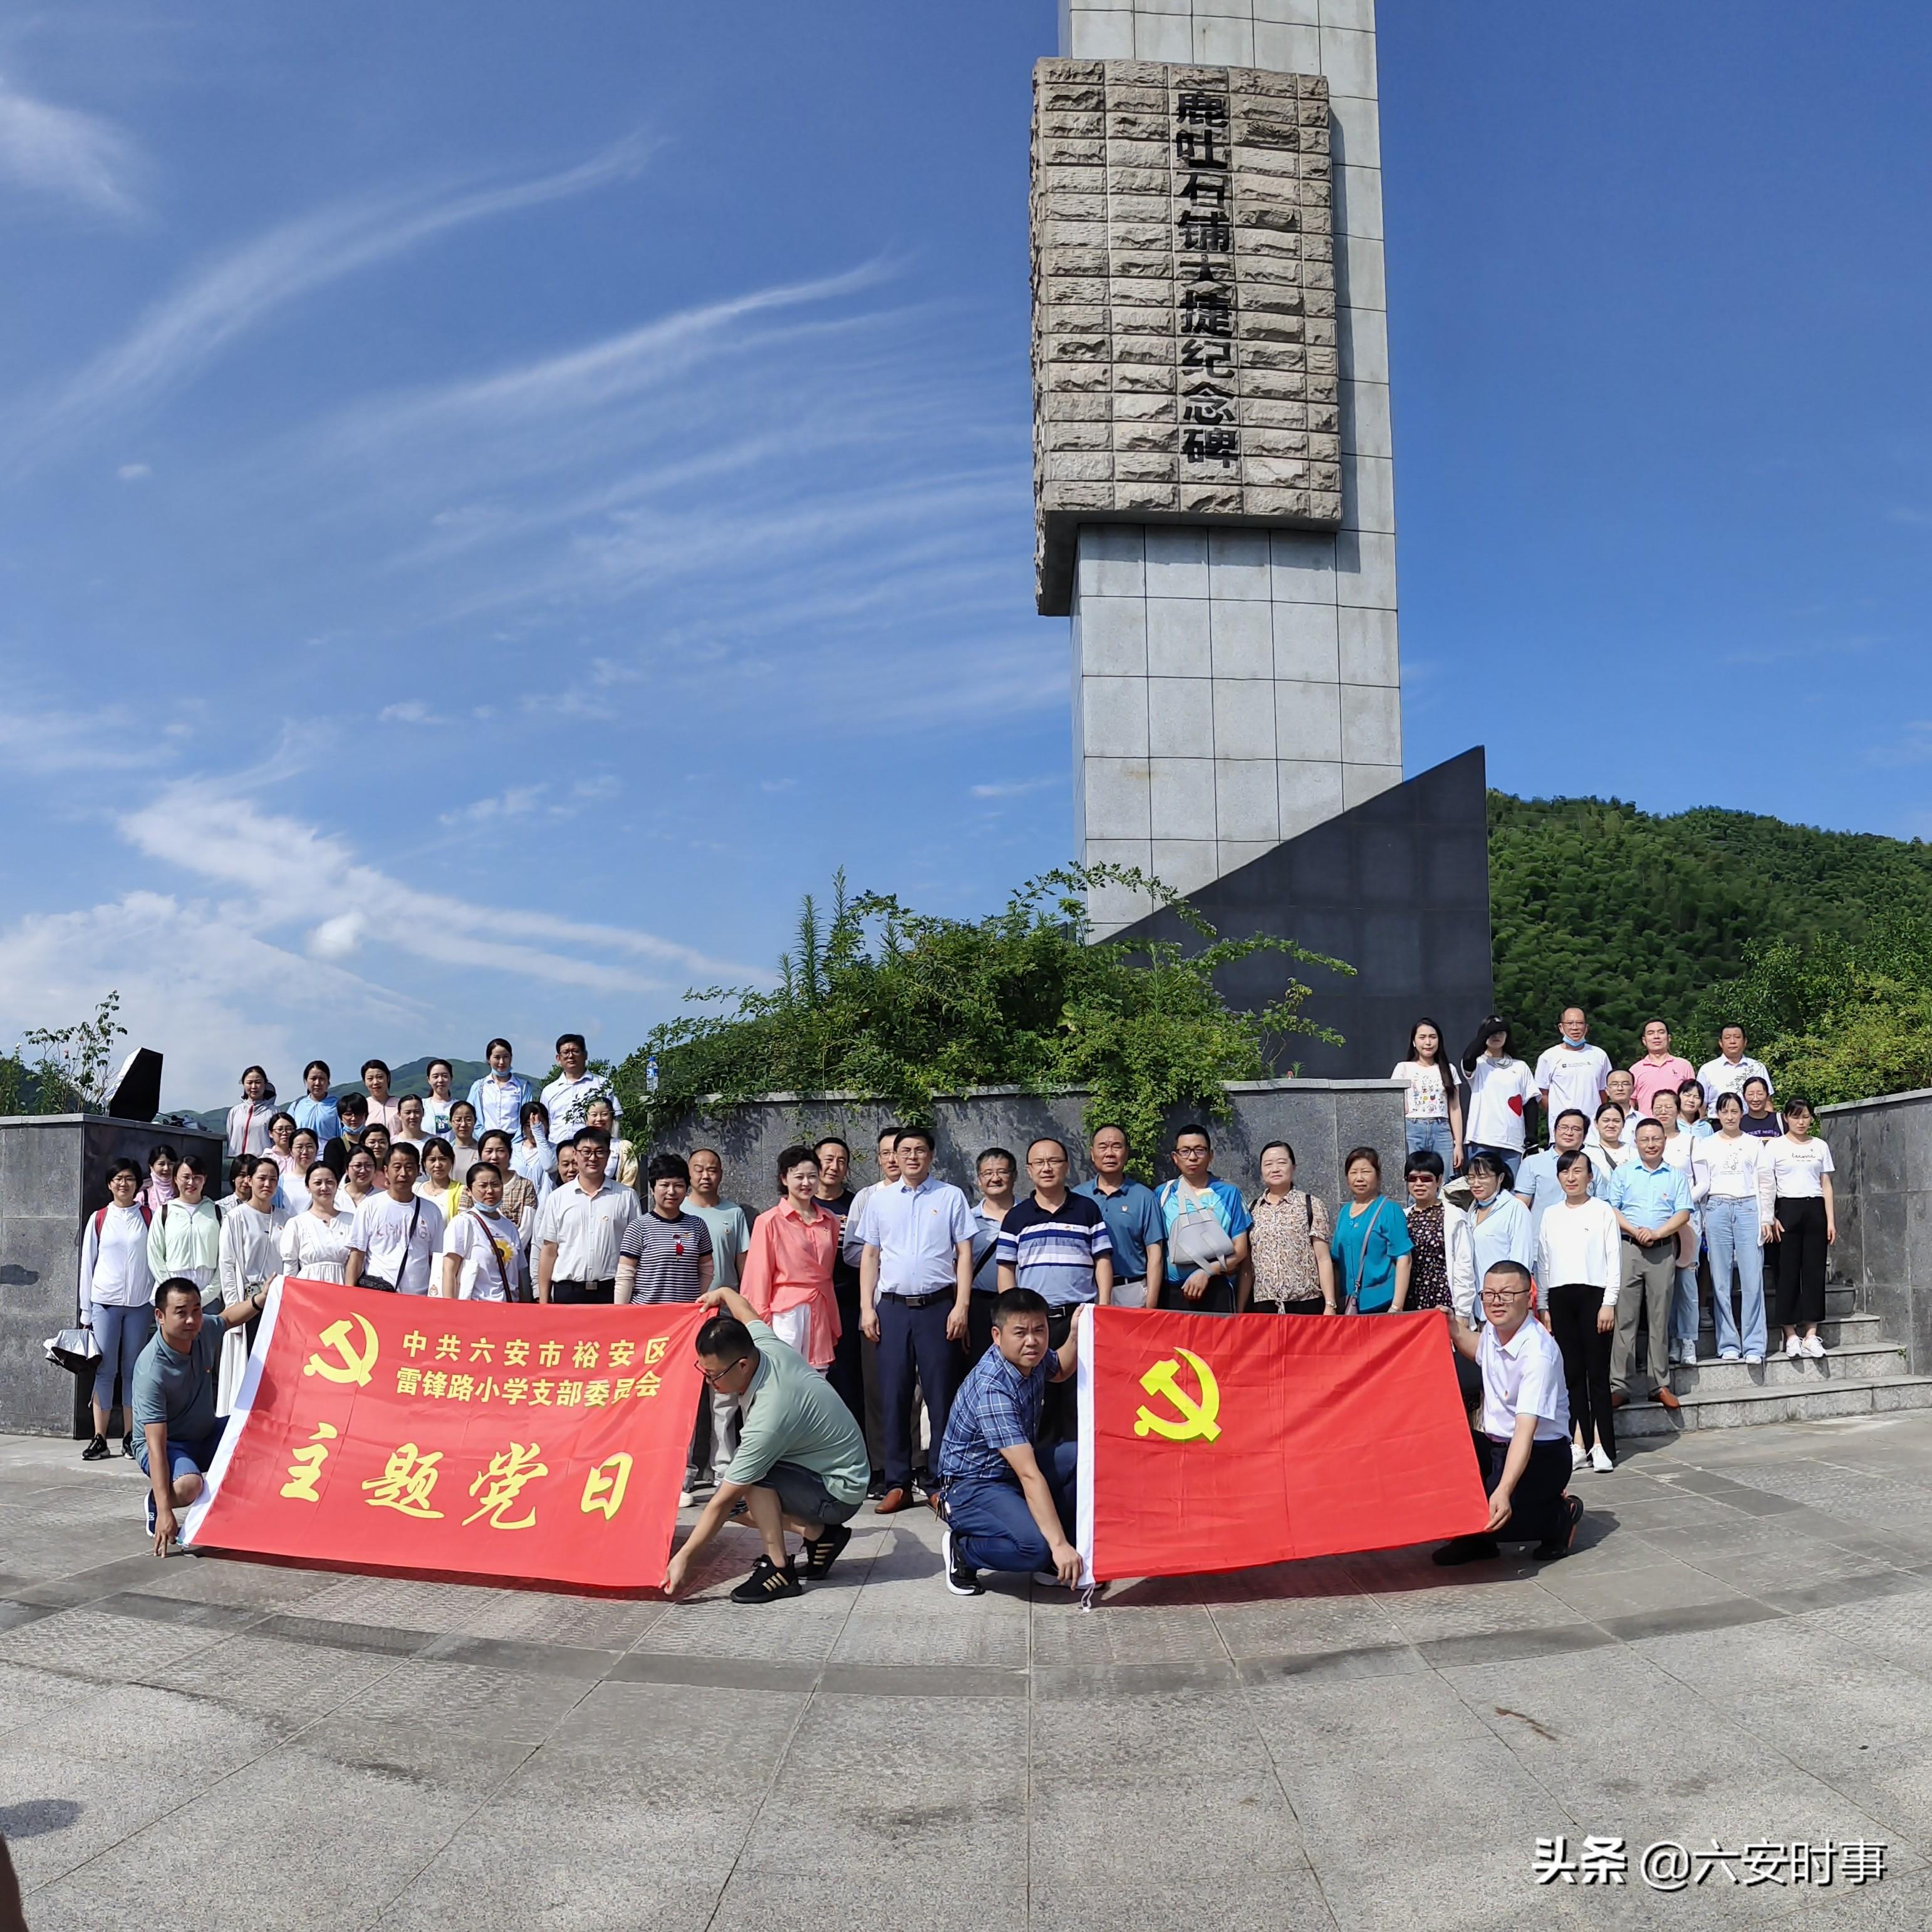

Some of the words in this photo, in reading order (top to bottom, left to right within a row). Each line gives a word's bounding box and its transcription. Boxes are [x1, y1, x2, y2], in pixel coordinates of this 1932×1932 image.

[1176, 91, 1239, 468] 鹿吐石铺大捷纪念碑
[402, 1330, 670, 1368] 中共六安市裕安区
[396, 1367, 662, 1408] 雷锋路小学支部委员会
[279, 1422, 635, 1530] 主题党日
